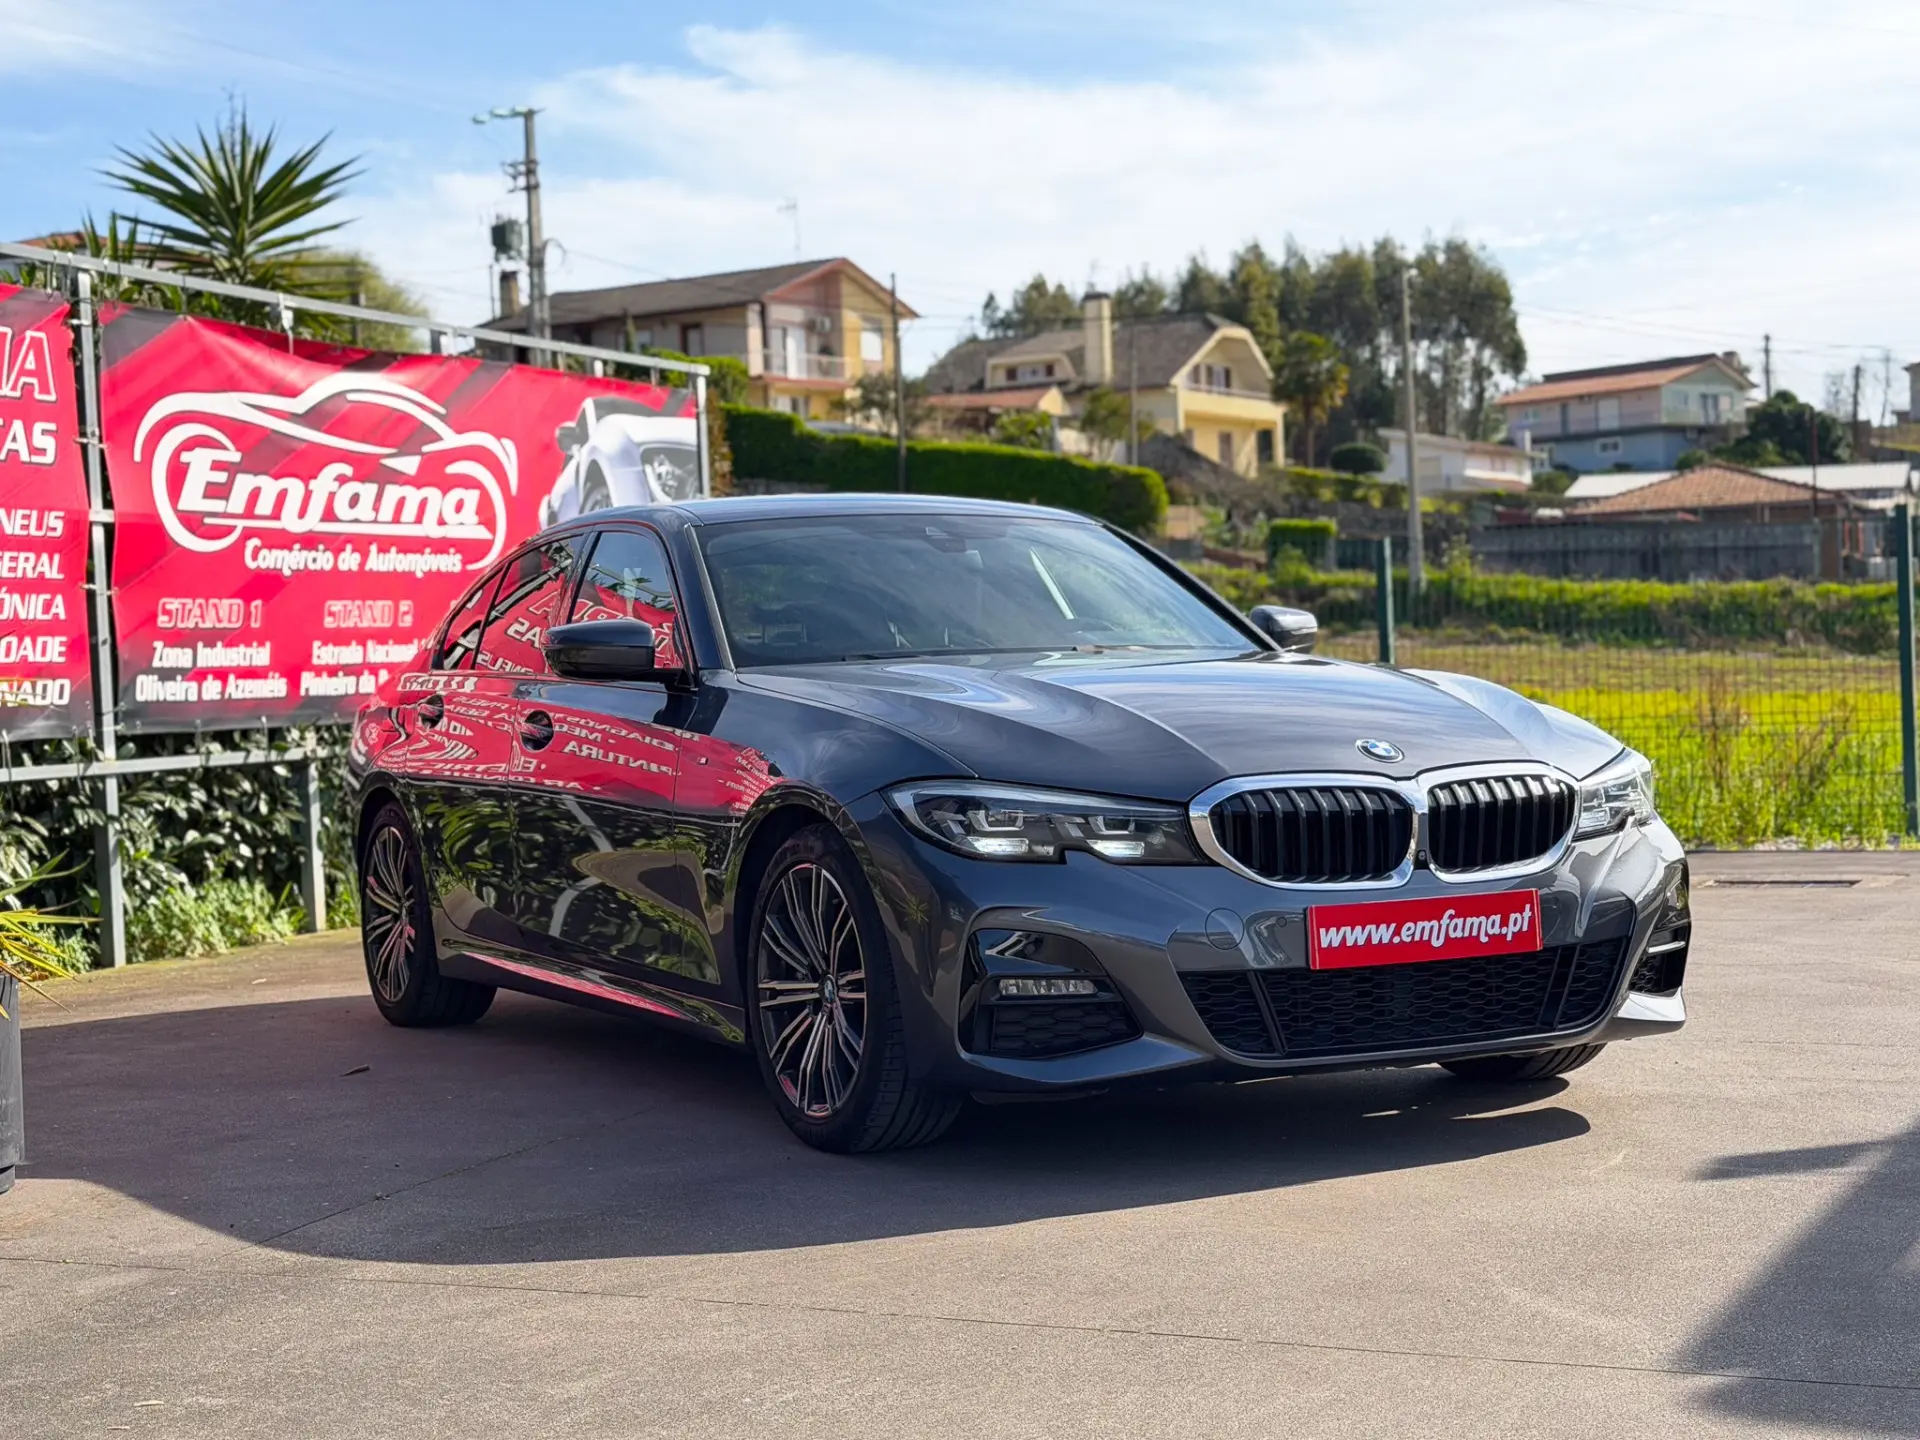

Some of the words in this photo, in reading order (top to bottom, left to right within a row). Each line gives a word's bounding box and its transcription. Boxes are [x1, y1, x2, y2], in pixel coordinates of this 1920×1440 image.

[0, 417, 57, 464] AS
[177, 447, 481, 538] Emfama
[0, 551, 65, 579] ERAL
[244, 538, 333, 577] Comércio
[337, 544, 361, 571] de
[365, 544, 463, 578] Automóveis
[157, 597, 244, 628] STAND
[250, 599, 263, 628] 1
[323, 600, 394, 628] STAND
[397, 600, 414, 627] 2
[152, 640, 193, 668] Zona
[196, 641, 271, 667] Industrial
[312, 640, 364, 665] Estrada
[135, 674, 199, 702] Oliveira
[201, 674, 222, 700] de
[224, 672, 288, 699] Azeméis
[300, 671, 357, 696] Pinheiro
[358, 669, 376, 694] da
[1319, 904, 1532, 948] www.emfama.pt
